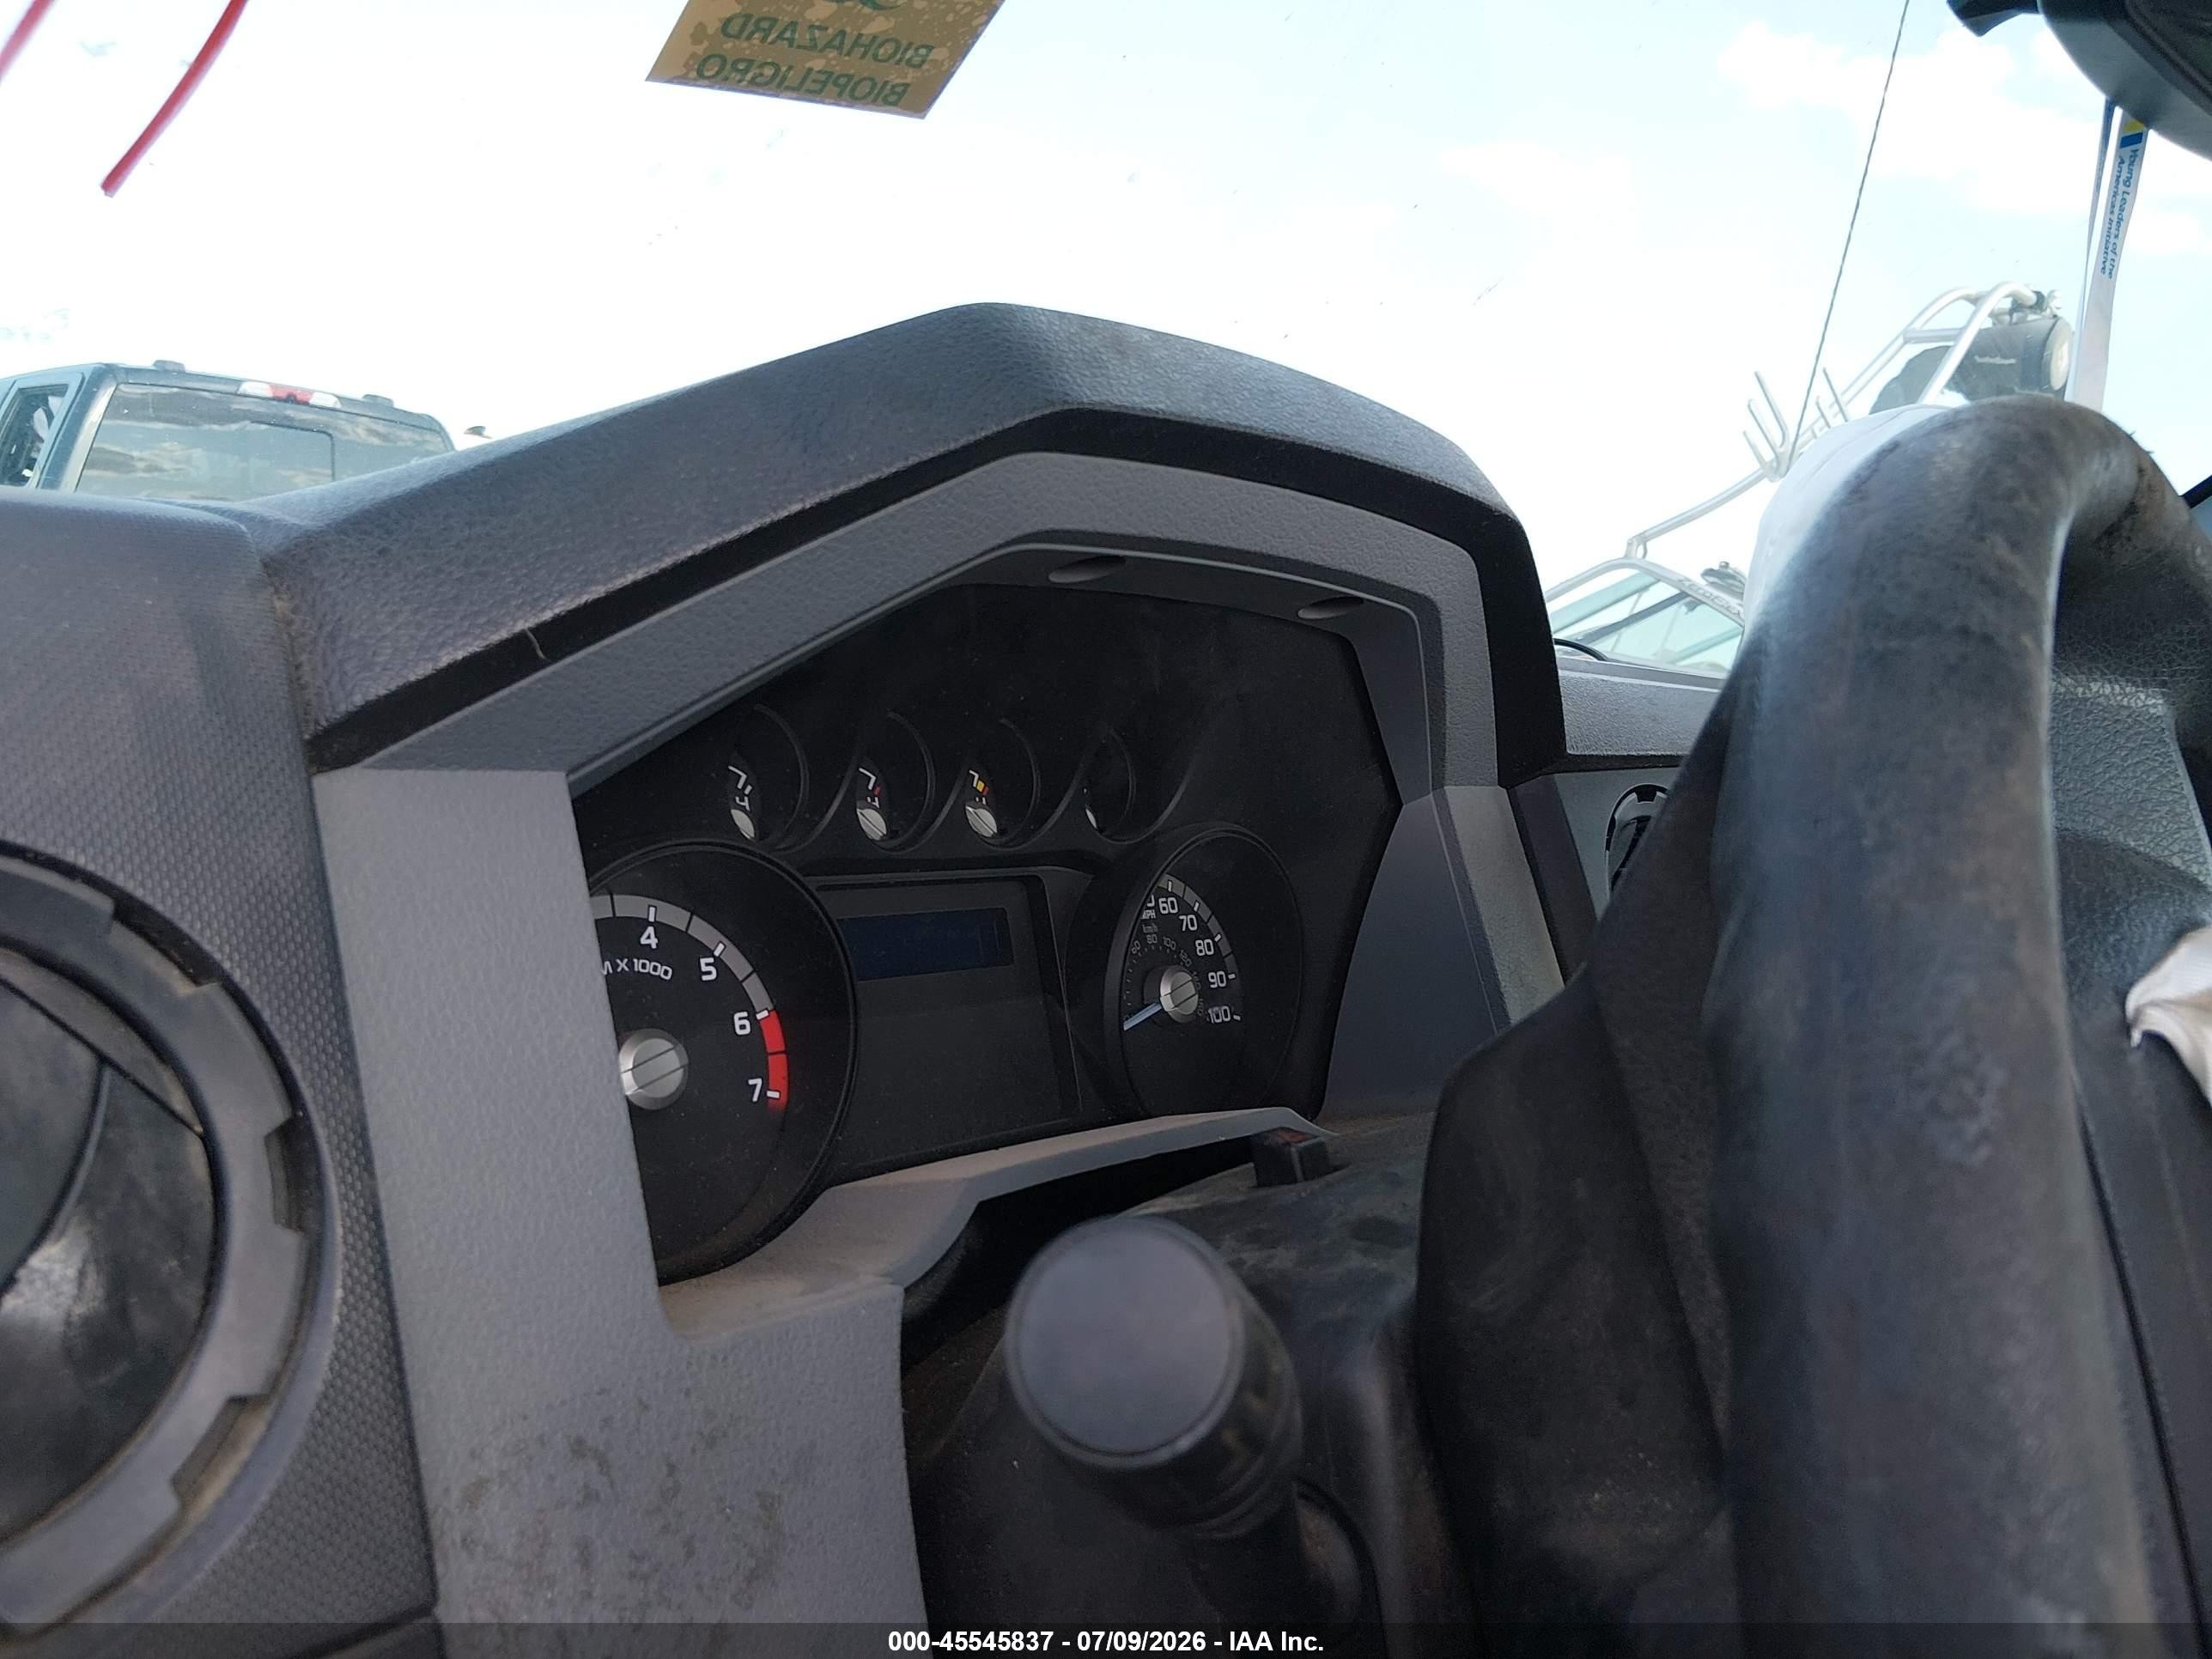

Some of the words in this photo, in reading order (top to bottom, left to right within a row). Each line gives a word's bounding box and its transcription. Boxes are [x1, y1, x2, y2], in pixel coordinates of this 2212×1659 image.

[2123, 149, 2139, 188] Young
[2109, 155, 2125, 216] Americas
[2114, 191, 2130, 240] Leaders
[2100, 217, 2114, 275] Initiative
[2112, 241, 2118, 256] of
[1159, 897, 1178, 915] 60
[1179, 915, 1198, 931] 70
[640, 927, 659, 949] 4
[1195, 939, 1214, 956] 80
[616, 958, 629, 972] X
[634, 958, 673, 981] 1000
[700, 957, 718, 981] 5
[1208, 971, 1227, 988] 90
[733, 1012, 751, 1036] 6
[1208, 1006, 1231, 1024] 100
[748, 1078, 763, 1102] 7
